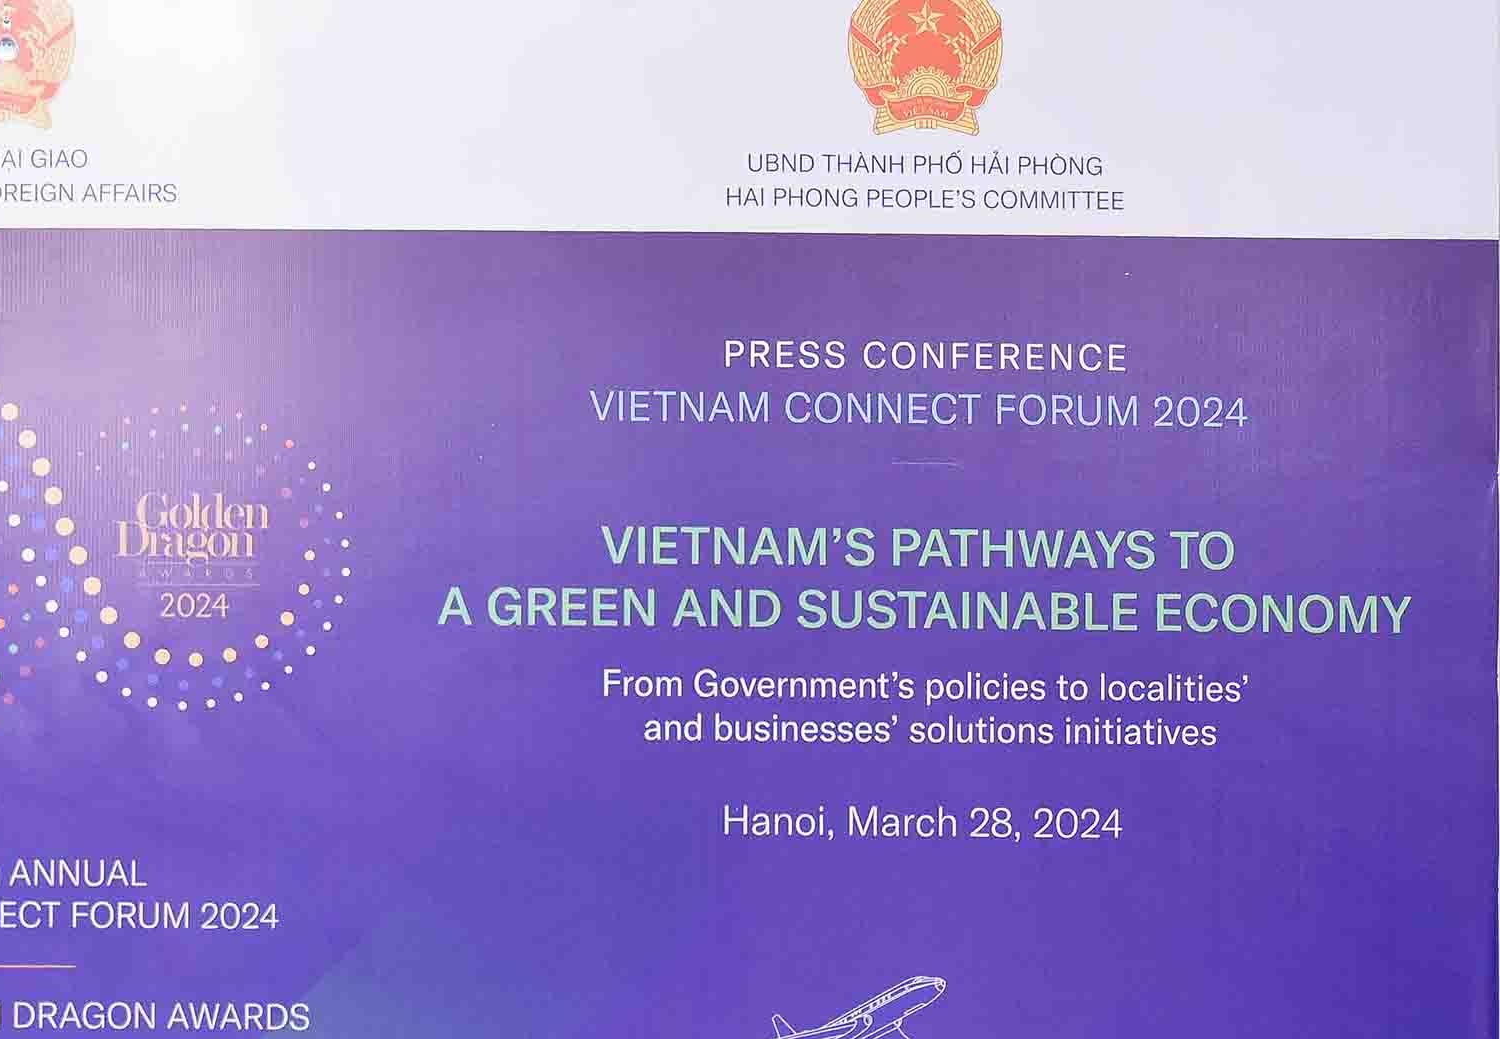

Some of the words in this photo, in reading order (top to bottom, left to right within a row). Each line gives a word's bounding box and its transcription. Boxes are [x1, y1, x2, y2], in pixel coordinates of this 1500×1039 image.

[30, 148, 88, 169] GIAO
[748, 153, 815, 173] UBND
[821, 151, 904, 175] THÀNH
[913, 149, 963, 175] PHỐ
[971, 150, 1009, 175] HẢI
[1018, 152, 1103, 177] PHÒNG
[81, 183, 177, 203] AFFAIRS
[726, 187, 764, 207] HAI
[773, 187, 858, 208] PHONG
[867, 188, 976, 209] PEOPLE'S
[983, 189, 1125, 211] COMMITTEE
[725, 340, 845, 369] PRESS
[863, 340, 1126, 372] CONFERENCE
[589, 390, 769, 423] VIETNAM
[784, 391, 982, 425] CONNECT
[996, 393, 1138, 427] FORUM
[1153, 395, 1248, 428] 2024
[136, 491, 271, 530] Golden
[114, 520, 257, 567] Dragon
[600, 525, 875, 567] VIETNAM'S
[892, 528, 1156, 570] PATHWAYS
[1169, 531, 1235, 571] TO
[160, 592, 229, 618] 2024
[437, 586, 473, 626] A
[487, 586, 655, 627] GREEN
[672, 588, 781, 628] AND
[796, 588, 1138, 631] SUSTAINABLE
[1156, 592, 1412, 634] ECONOMY
[603, 668, 683, 697] From
[693, 668, 915, 700] Government's
[926, 671, 1046, 707] policies
[1055, 674, 1089, 701] to
[1100, 672, 1249, 703] localities'
[643, 712, 702, 742] and
[714, 712, 898, 743] businesses'
[909, 714, 1054, 745] solutions
[1065, 716, 1217, 746] initiatives
[723, 804, 834, 841] Hanoi,
[848, 805, 957, 838] March
[969, 807, 1021, 843] 28,
[1033, 807, 1123, 839] 2024
[9, 858, 148, 887] ANNUAL
[72, 900, 189, 929] FORUM
[201, 902, 280, 930] 2024
[13, 1000, 156, 1030] DRAGON
[166, 1002, 310, 1031] AWARDS
